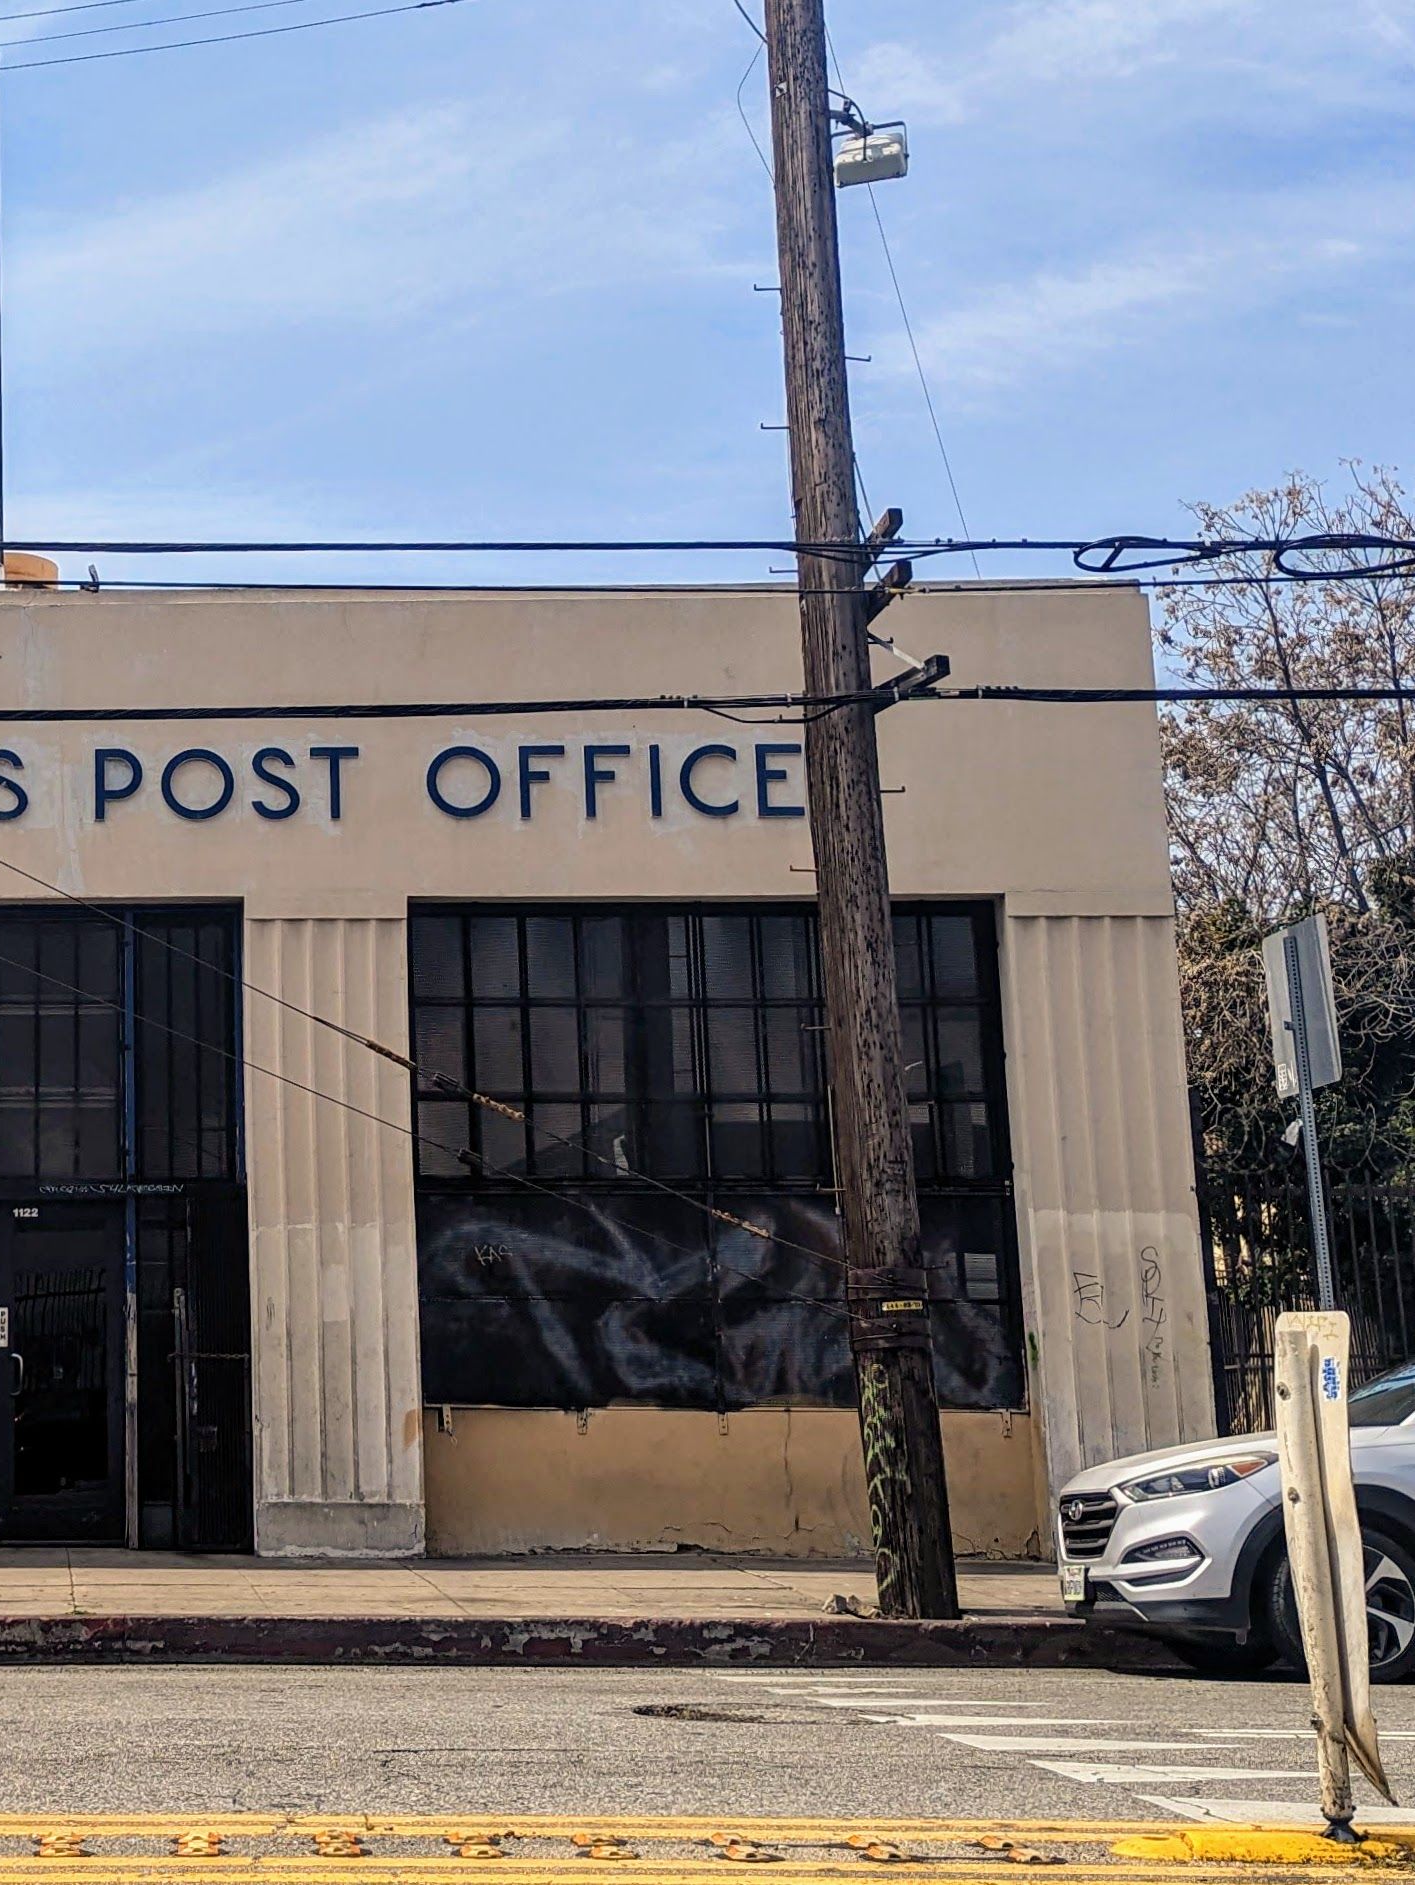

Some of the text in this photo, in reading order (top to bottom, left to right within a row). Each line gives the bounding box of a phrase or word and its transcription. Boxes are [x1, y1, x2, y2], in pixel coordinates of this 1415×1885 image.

[94, 745, 360, 821] POST
[426, 743, 806, 820] OFFICE
[12, 1207, 39, 1218] 1122
